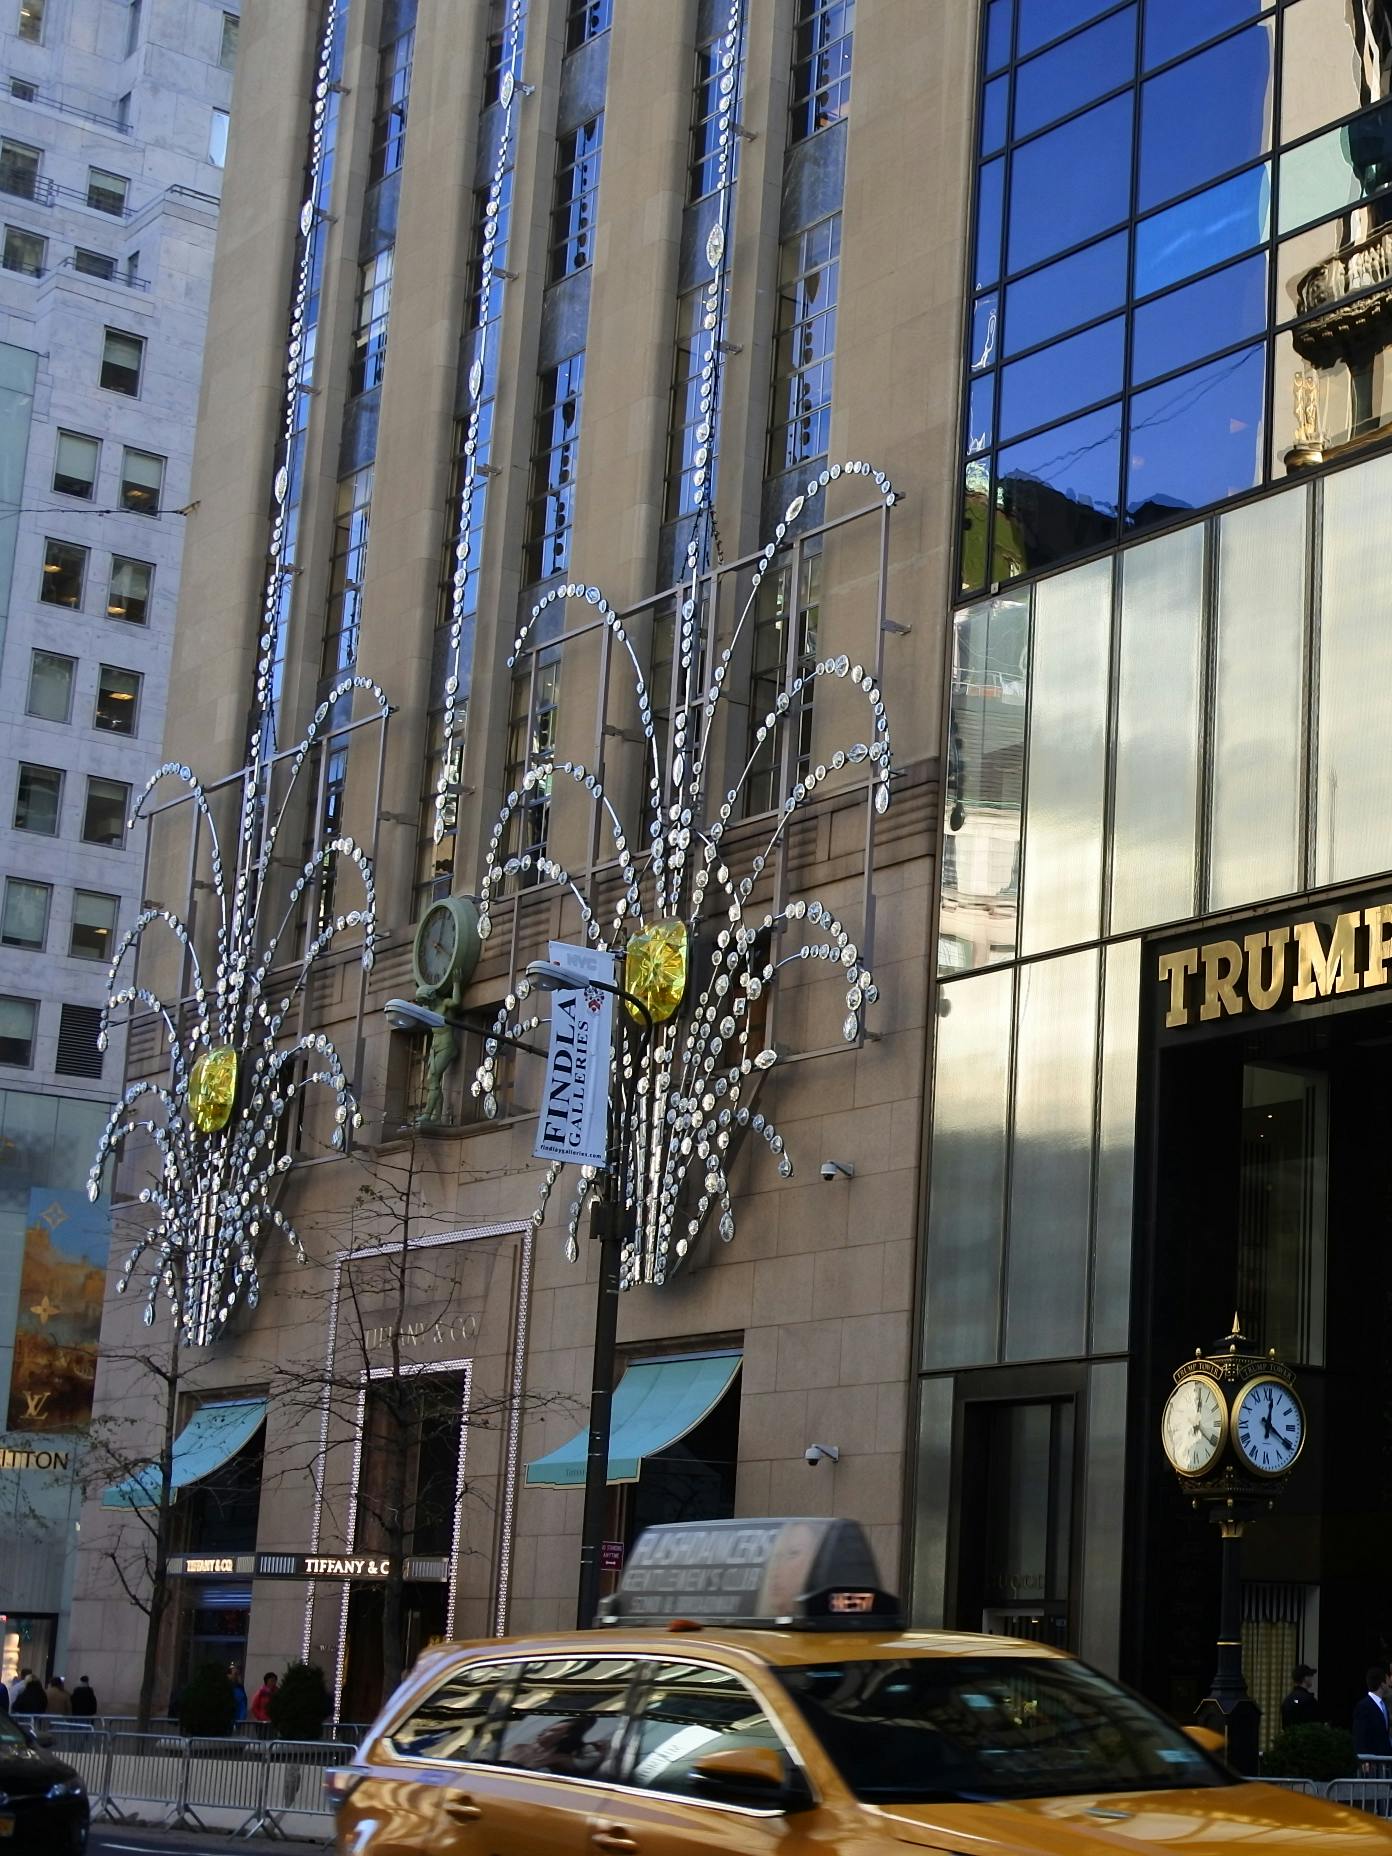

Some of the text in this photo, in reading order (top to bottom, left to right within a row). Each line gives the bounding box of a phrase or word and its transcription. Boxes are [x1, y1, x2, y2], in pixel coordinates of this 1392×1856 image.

[543, 989, 577, 1147] FINDLA
[568, 1019, 589, 1147] GALLERIES
[540, 1144, 602, 1159] findlaygalleries.com
[1177, 1362, 1219, 1379] TRUMP TOWER
[1243, 1363, 1292, 1380] TRUMP TOWER
[2, 1449, 69, 1470] ITTON
[305, 1559, 391, 1575] TIFFANY & C
